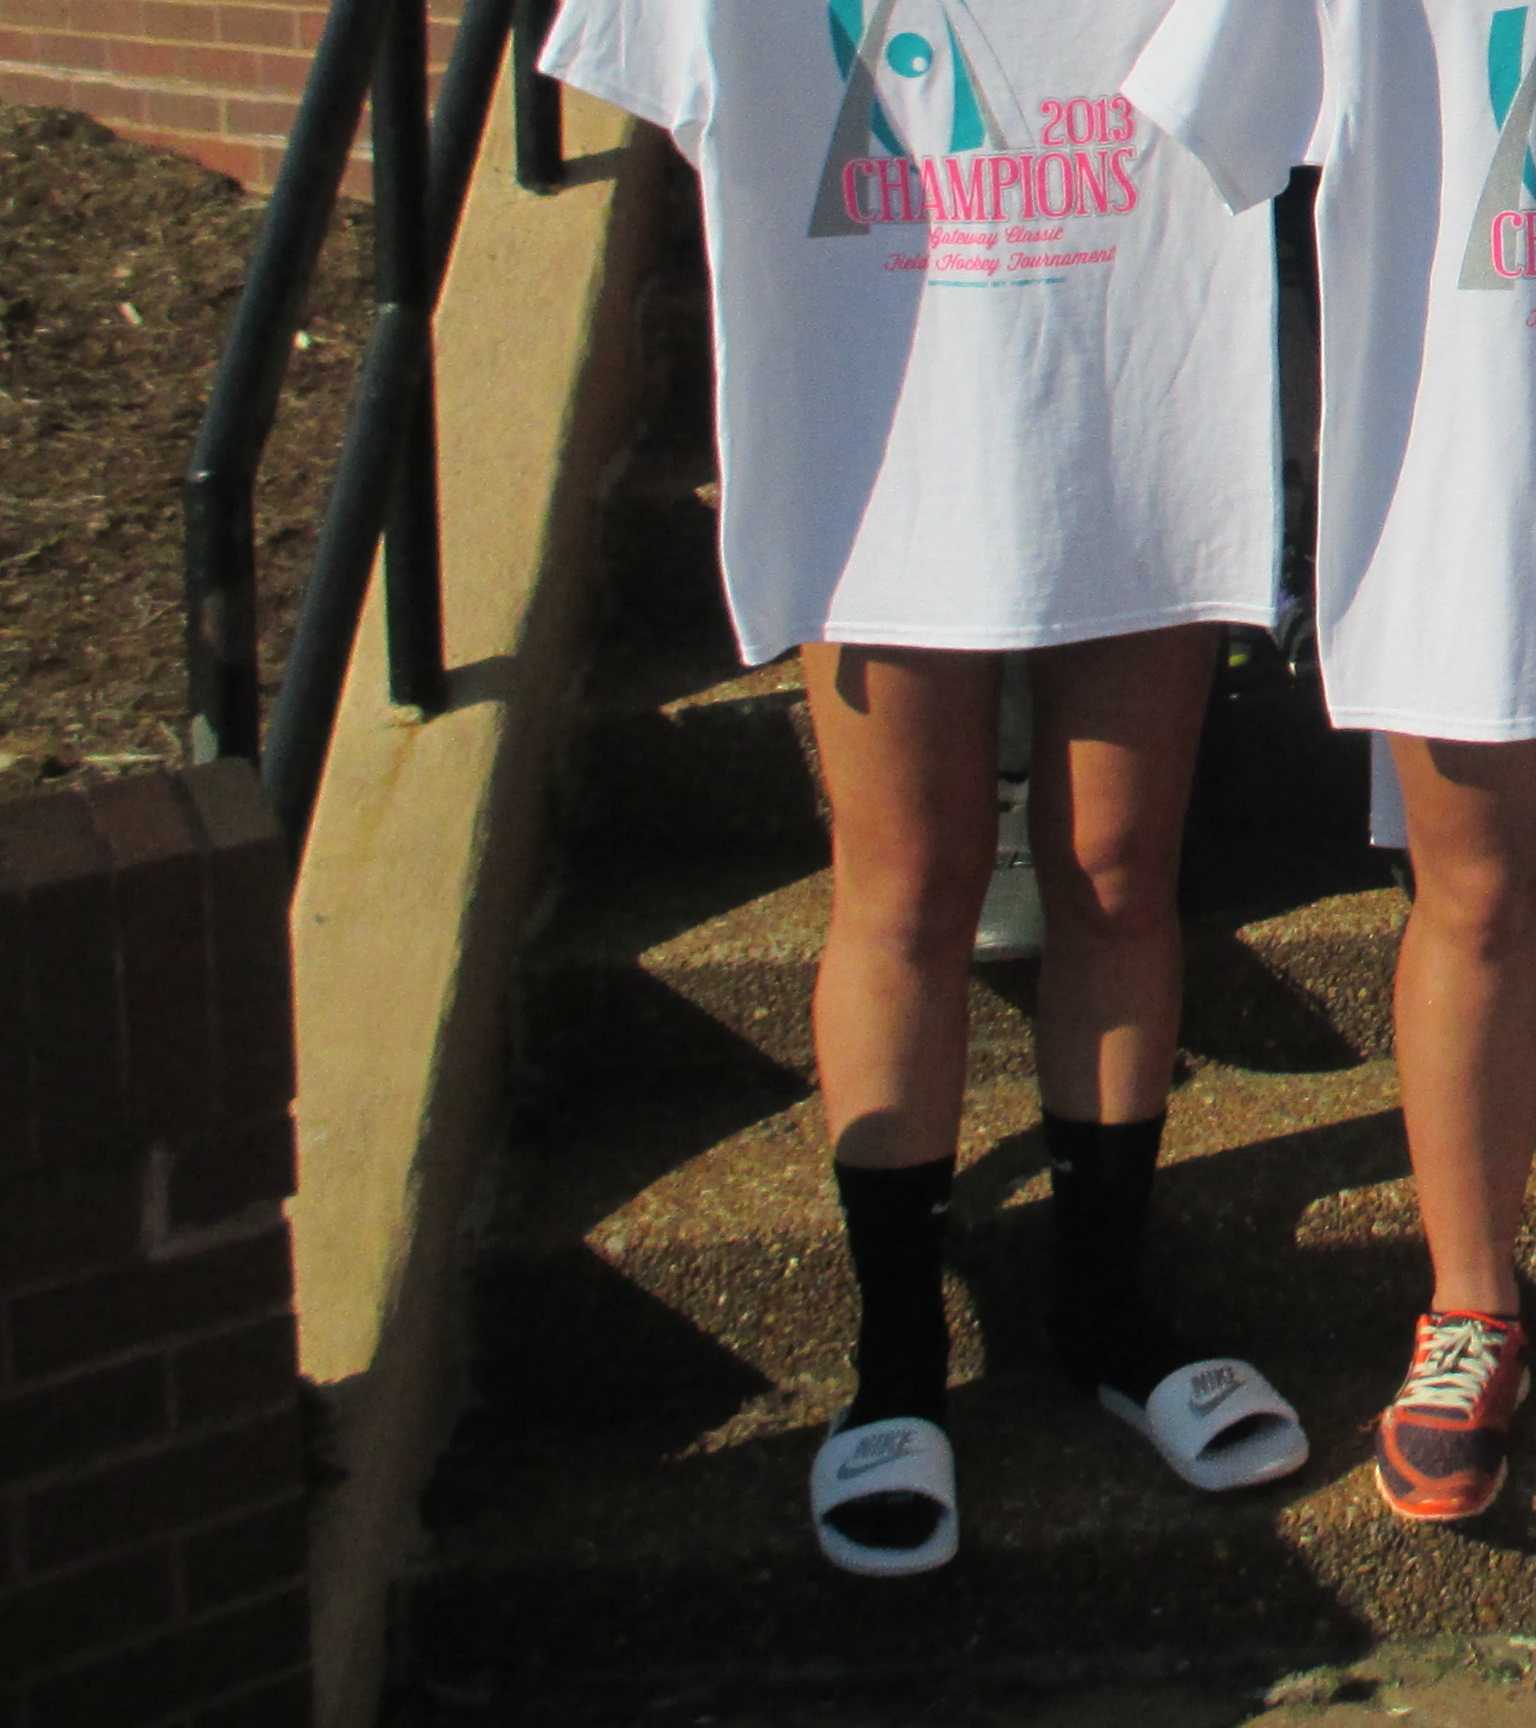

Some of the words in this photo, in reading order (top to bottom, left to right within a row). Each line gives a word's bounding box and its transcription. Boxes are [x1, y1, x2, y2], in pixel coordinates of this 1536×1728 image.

[1040, 96, 1138, 147] 2013
[842, 145, 1140, 225] CHAMPIONS
[928, 226, 999, 251] Gateway
[1004, 225, 1064, 245] Classic
[934, 252, 1000, 276] Hockey
[1006, 244, 1117, 272] Tournament
